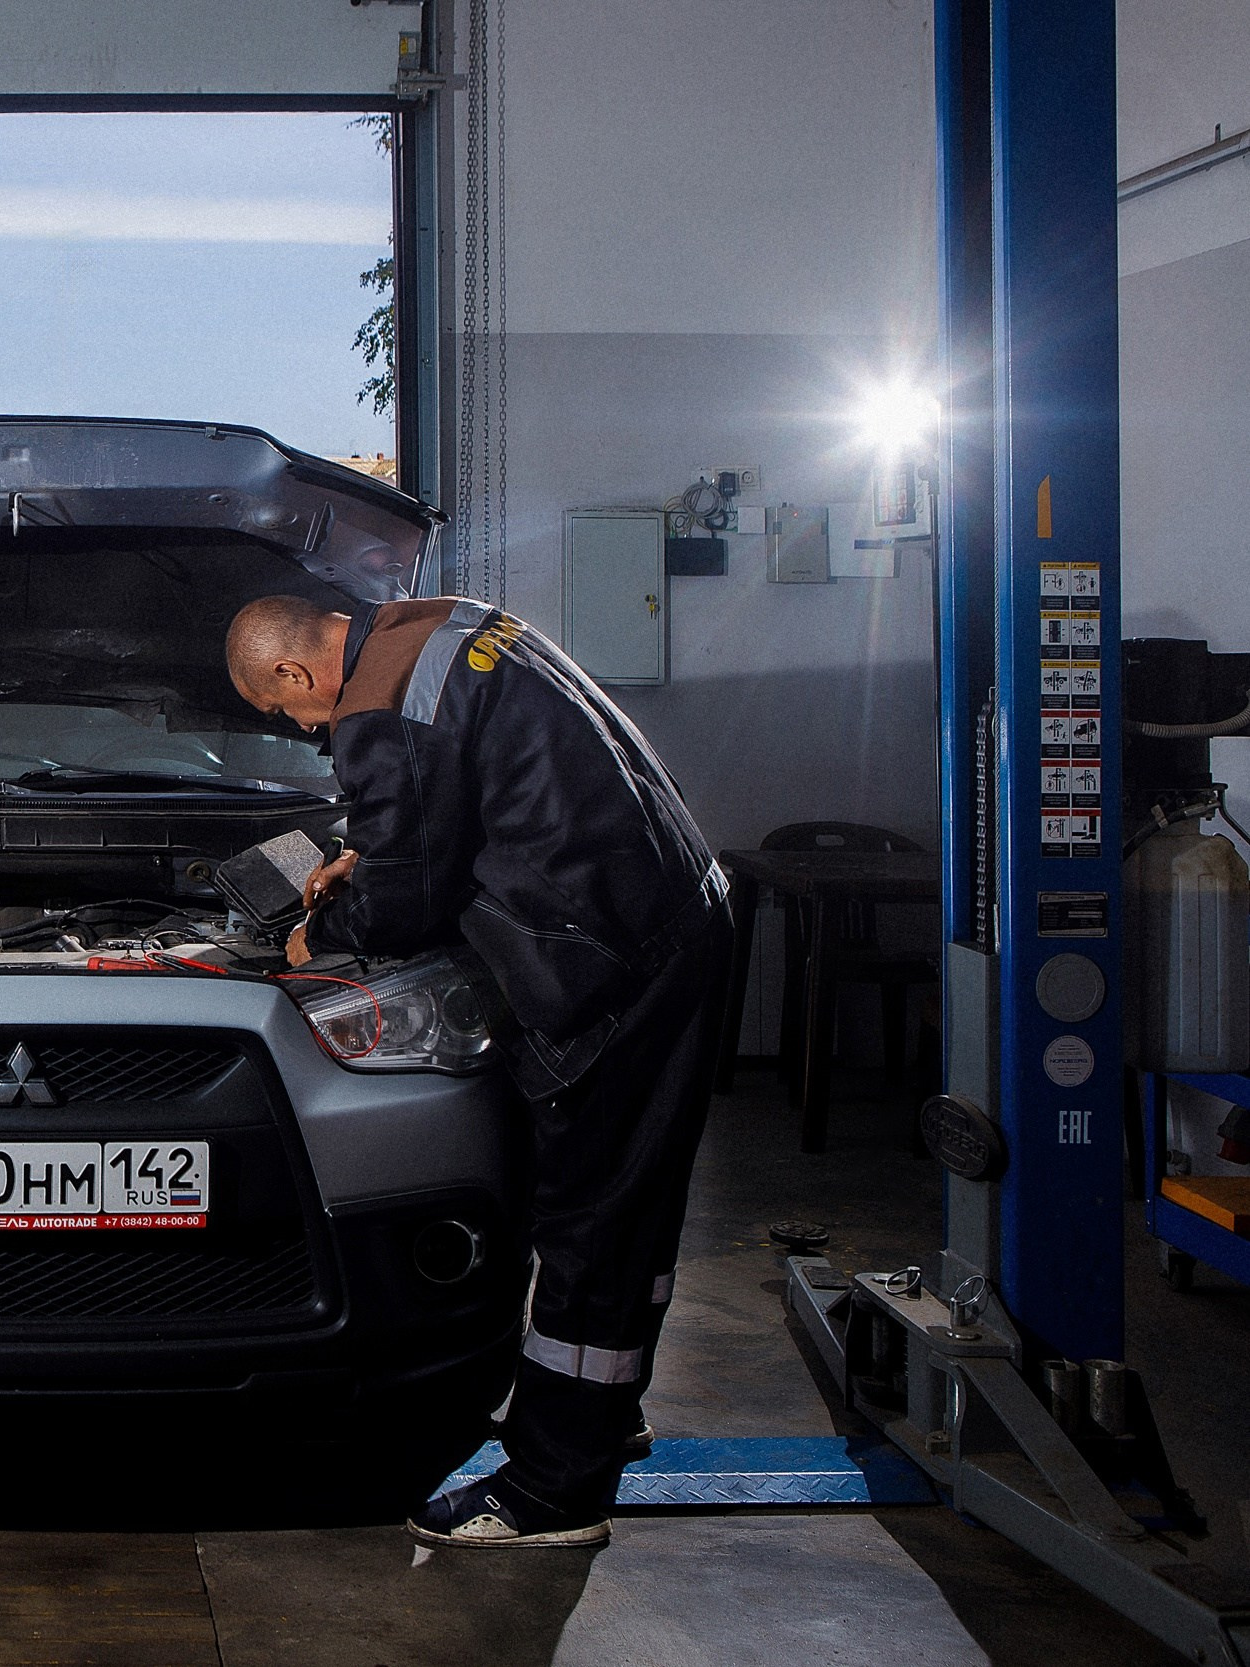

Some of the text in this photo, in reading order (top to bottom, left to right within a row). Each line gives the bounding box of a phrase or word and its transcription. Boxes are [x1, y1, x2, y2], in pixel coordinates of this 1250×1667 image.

[1058, 1110, 1093, 1144] EAC
[109, 1147, 194, 1190] 142
[127, 1190, 168, 1206] RUS
[32, 1218, 97, 1228] AUTOTRADE
[104, 1217, 118, 1226] +7
[120, 1216, 152, 1227] (3842)
[155, 1216, 199, 1226] 48-00-00
